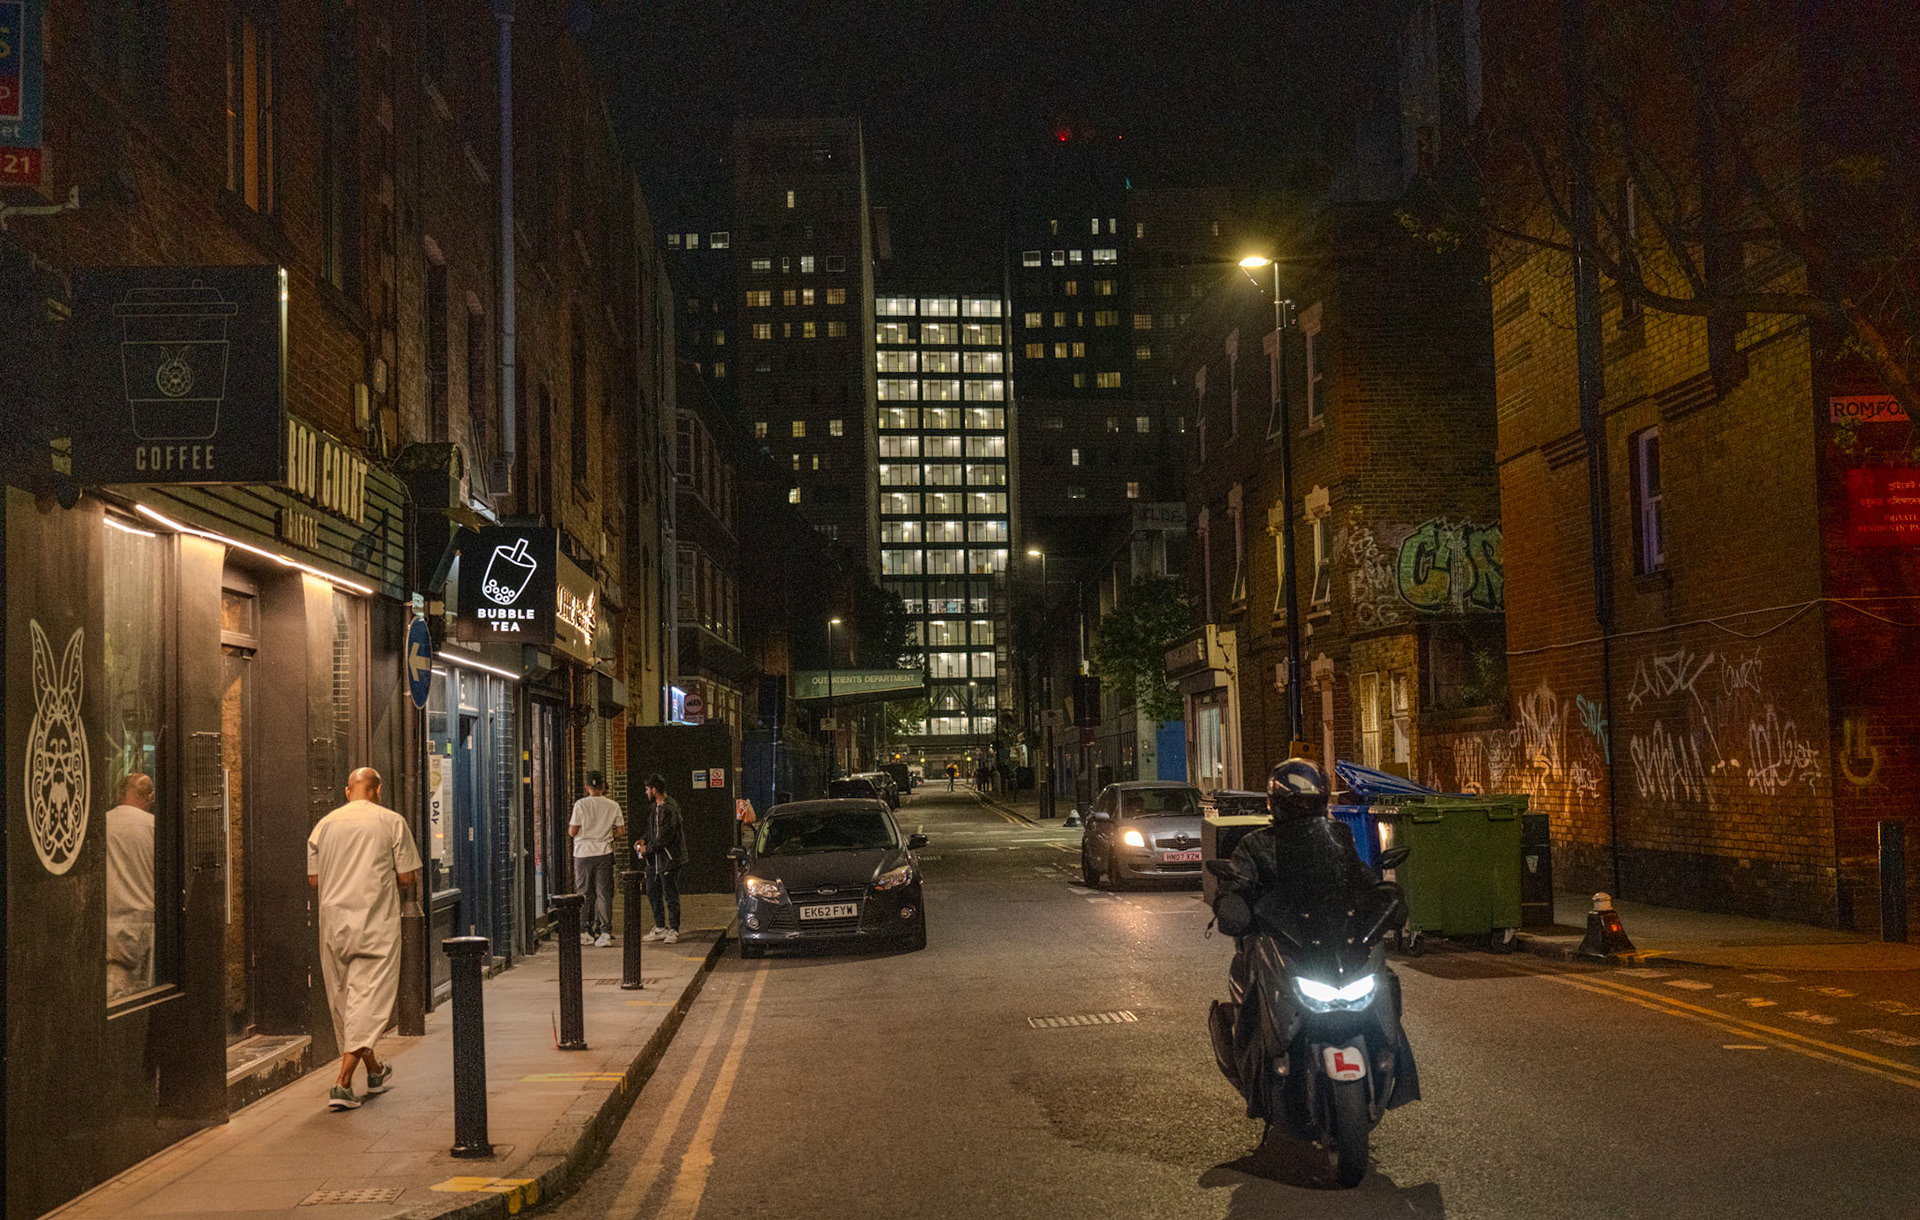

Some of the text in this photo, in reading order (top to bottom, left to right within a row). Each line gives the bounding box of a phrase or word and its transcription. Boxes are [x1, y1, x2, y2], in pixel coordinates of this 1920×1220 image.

[1834, 401, 1905, 416] ROMFO
[136, 445, 214, 470] COFFEE
[322, 441, 367, 523] COURT
[477, 608, 535, 619] BUBBLE
[491, 621, 521, 632] TEA
[812, 674, 915, 685] OUTATIENTS DEPARTMENT
[431, 800, 440, 825] DAY
[804, 907, 831, 918] EK62
[1334, 1052, 1360, 1073] L
